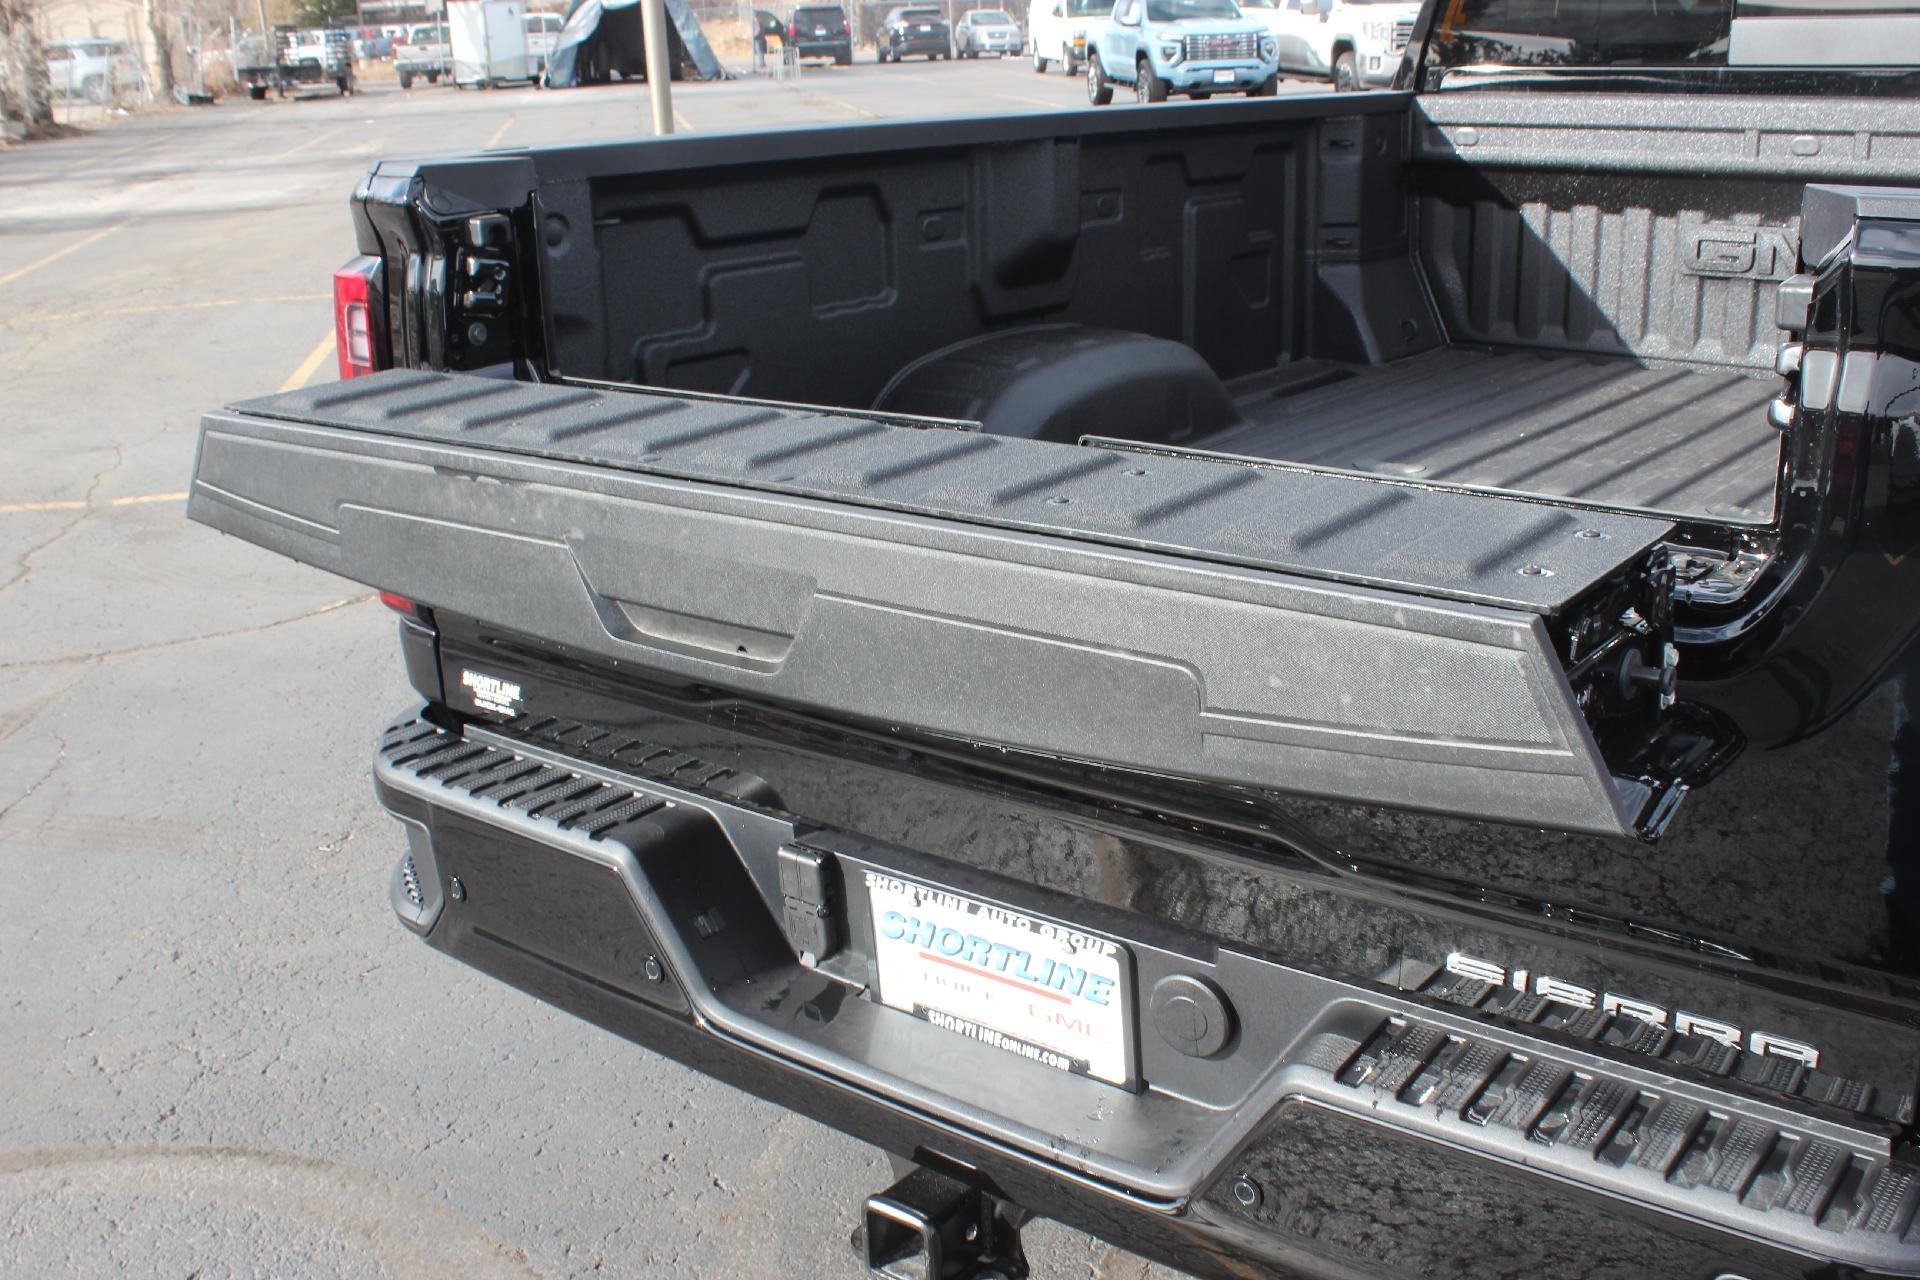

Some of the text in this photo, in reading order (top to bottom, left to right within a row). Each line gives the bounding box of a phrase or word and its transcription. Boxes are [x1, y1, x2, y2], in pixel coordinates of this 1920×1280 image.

[1685, 229, 1799, 275] GM
[865, 872, 1117, 956] SHORTLINE AUTO GROUP
[880, 910, 1116, 1006] SHORTLINE
[1446, 952, 1821, 1069] SIERRA
